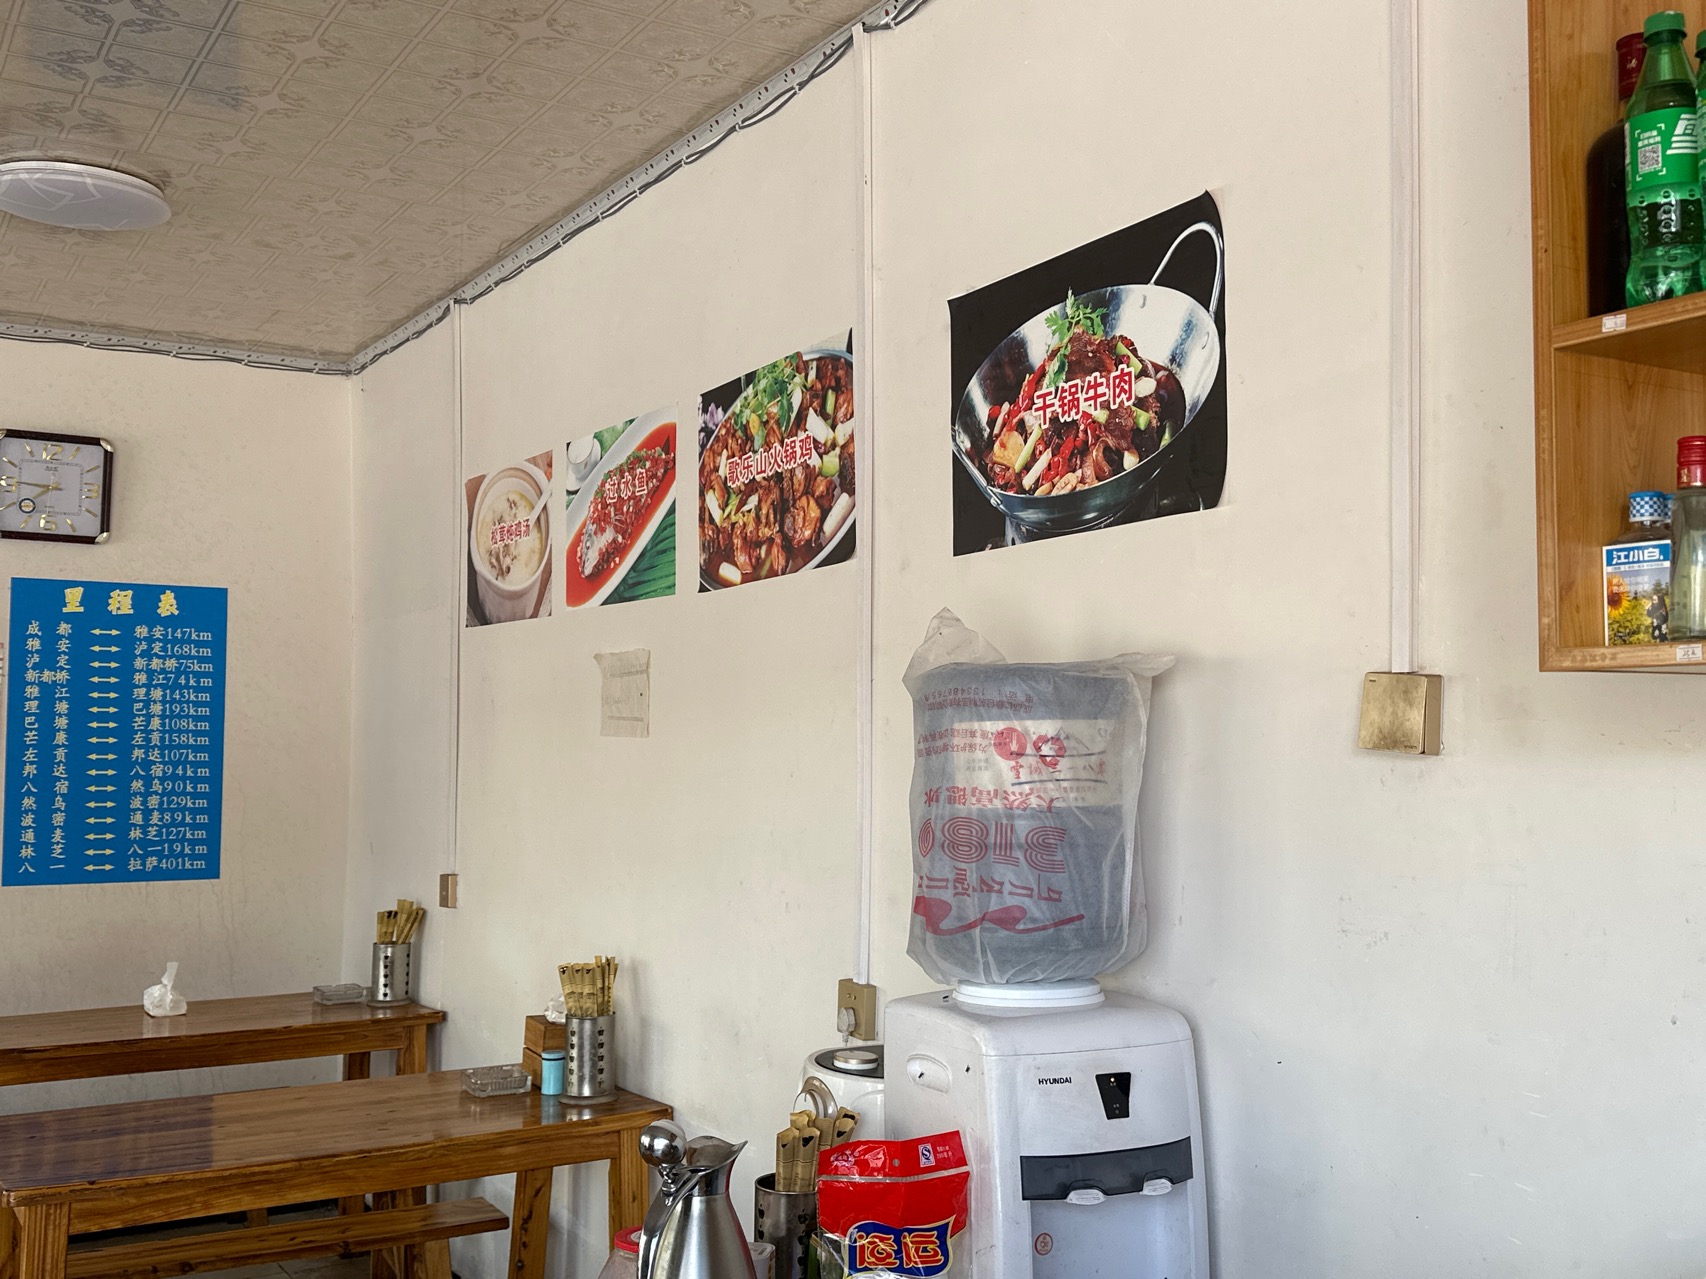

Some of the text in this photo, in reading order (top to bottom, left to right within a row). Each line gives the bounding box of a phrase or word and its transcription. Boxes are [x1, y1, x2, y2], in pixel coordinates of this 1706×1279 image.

[1033, 364, 1135, 429] 干锅牛肉
[42, 444, 64, 461] 12
[727, 432, 813, 487] 歌乐山火锅鸡
[82, 482, 100, 499] 3
[605, 468, 647, 504] 过水鱼
[40, 514, 57, 531] 6
[1612, 548, 1660, 564] 江小白
[62, 587, 180, 616] 里程表
[1038, 1076, 1072, 1085] HYUNDAI
